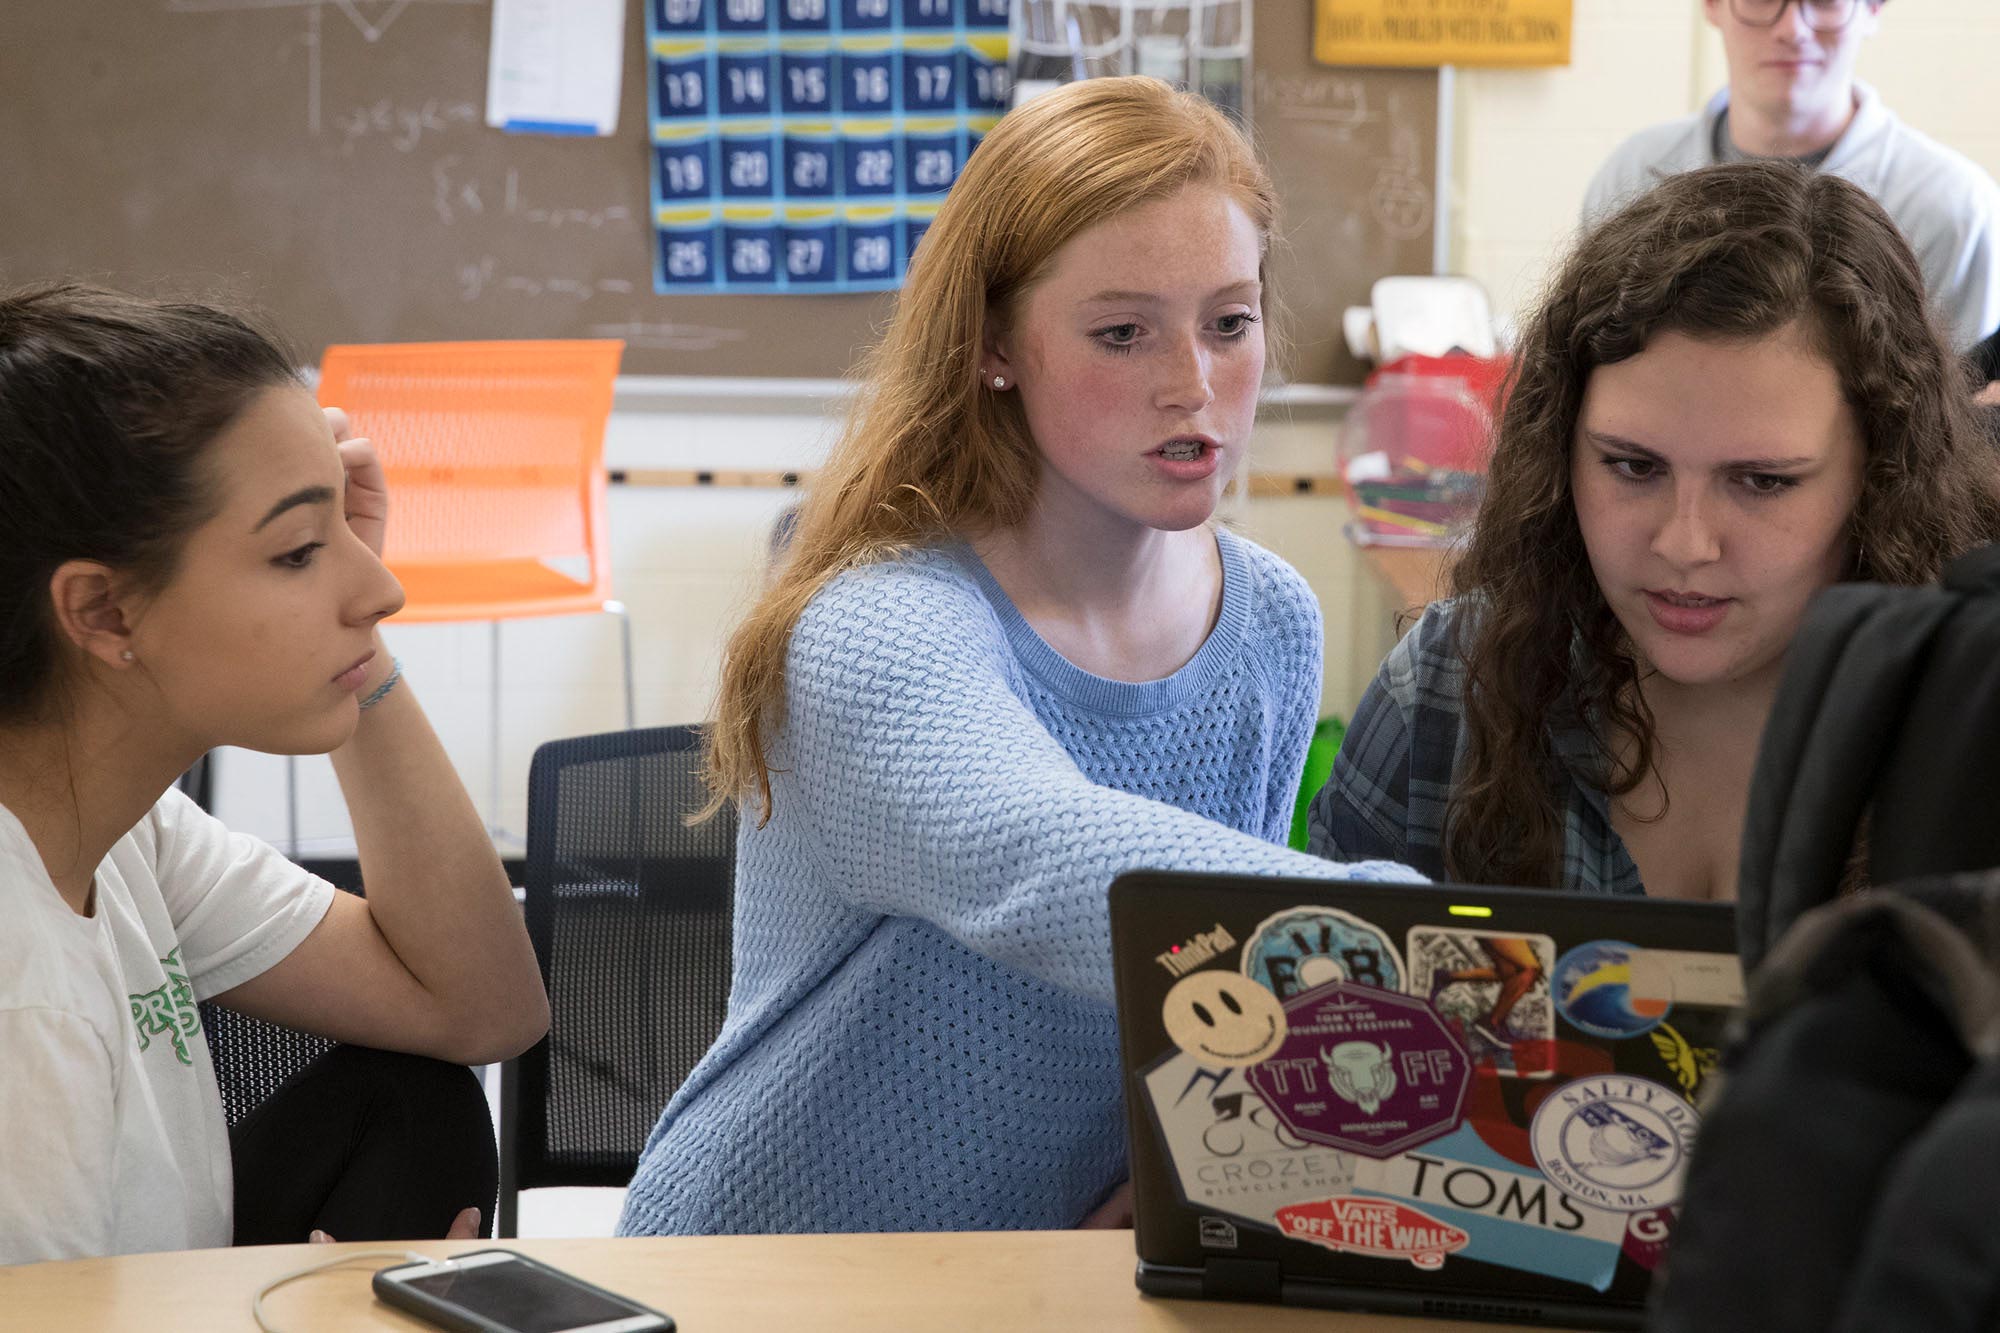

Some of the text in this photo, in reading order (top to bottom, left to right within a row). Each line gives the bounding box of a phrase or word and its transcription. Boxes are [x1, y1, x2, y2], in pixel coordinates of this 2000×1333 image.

[665, 71, 702, 108] 13
[728, 67, 765, 104] 14
[788, 66, 825, 103] 15
[853, 66, 889, 103] 16
[915, 65, 951, 101] 17
[666, 149, 953, 192] 19 20 21 22 23
[668, 236, 891, 277] 25 26 27 28
[1315, 1012, 1377, 1024] TOM TOM
[1356, 1019, 1412, 1031] FESTIVAL
[1262, 1050, 1453, 1095] TT FF
[1561, 1081, 1659, 1107] SALTY
[1197, 1152, 1345, 1184] CROZET
[1204, 1182, 1289, 1197] BICYCLE
[1405, 1151, 1584, 1231] TOMS
[1331, 1200, 1399, 1226] VANS
[1338, 1221, 1388, 1249] THE
